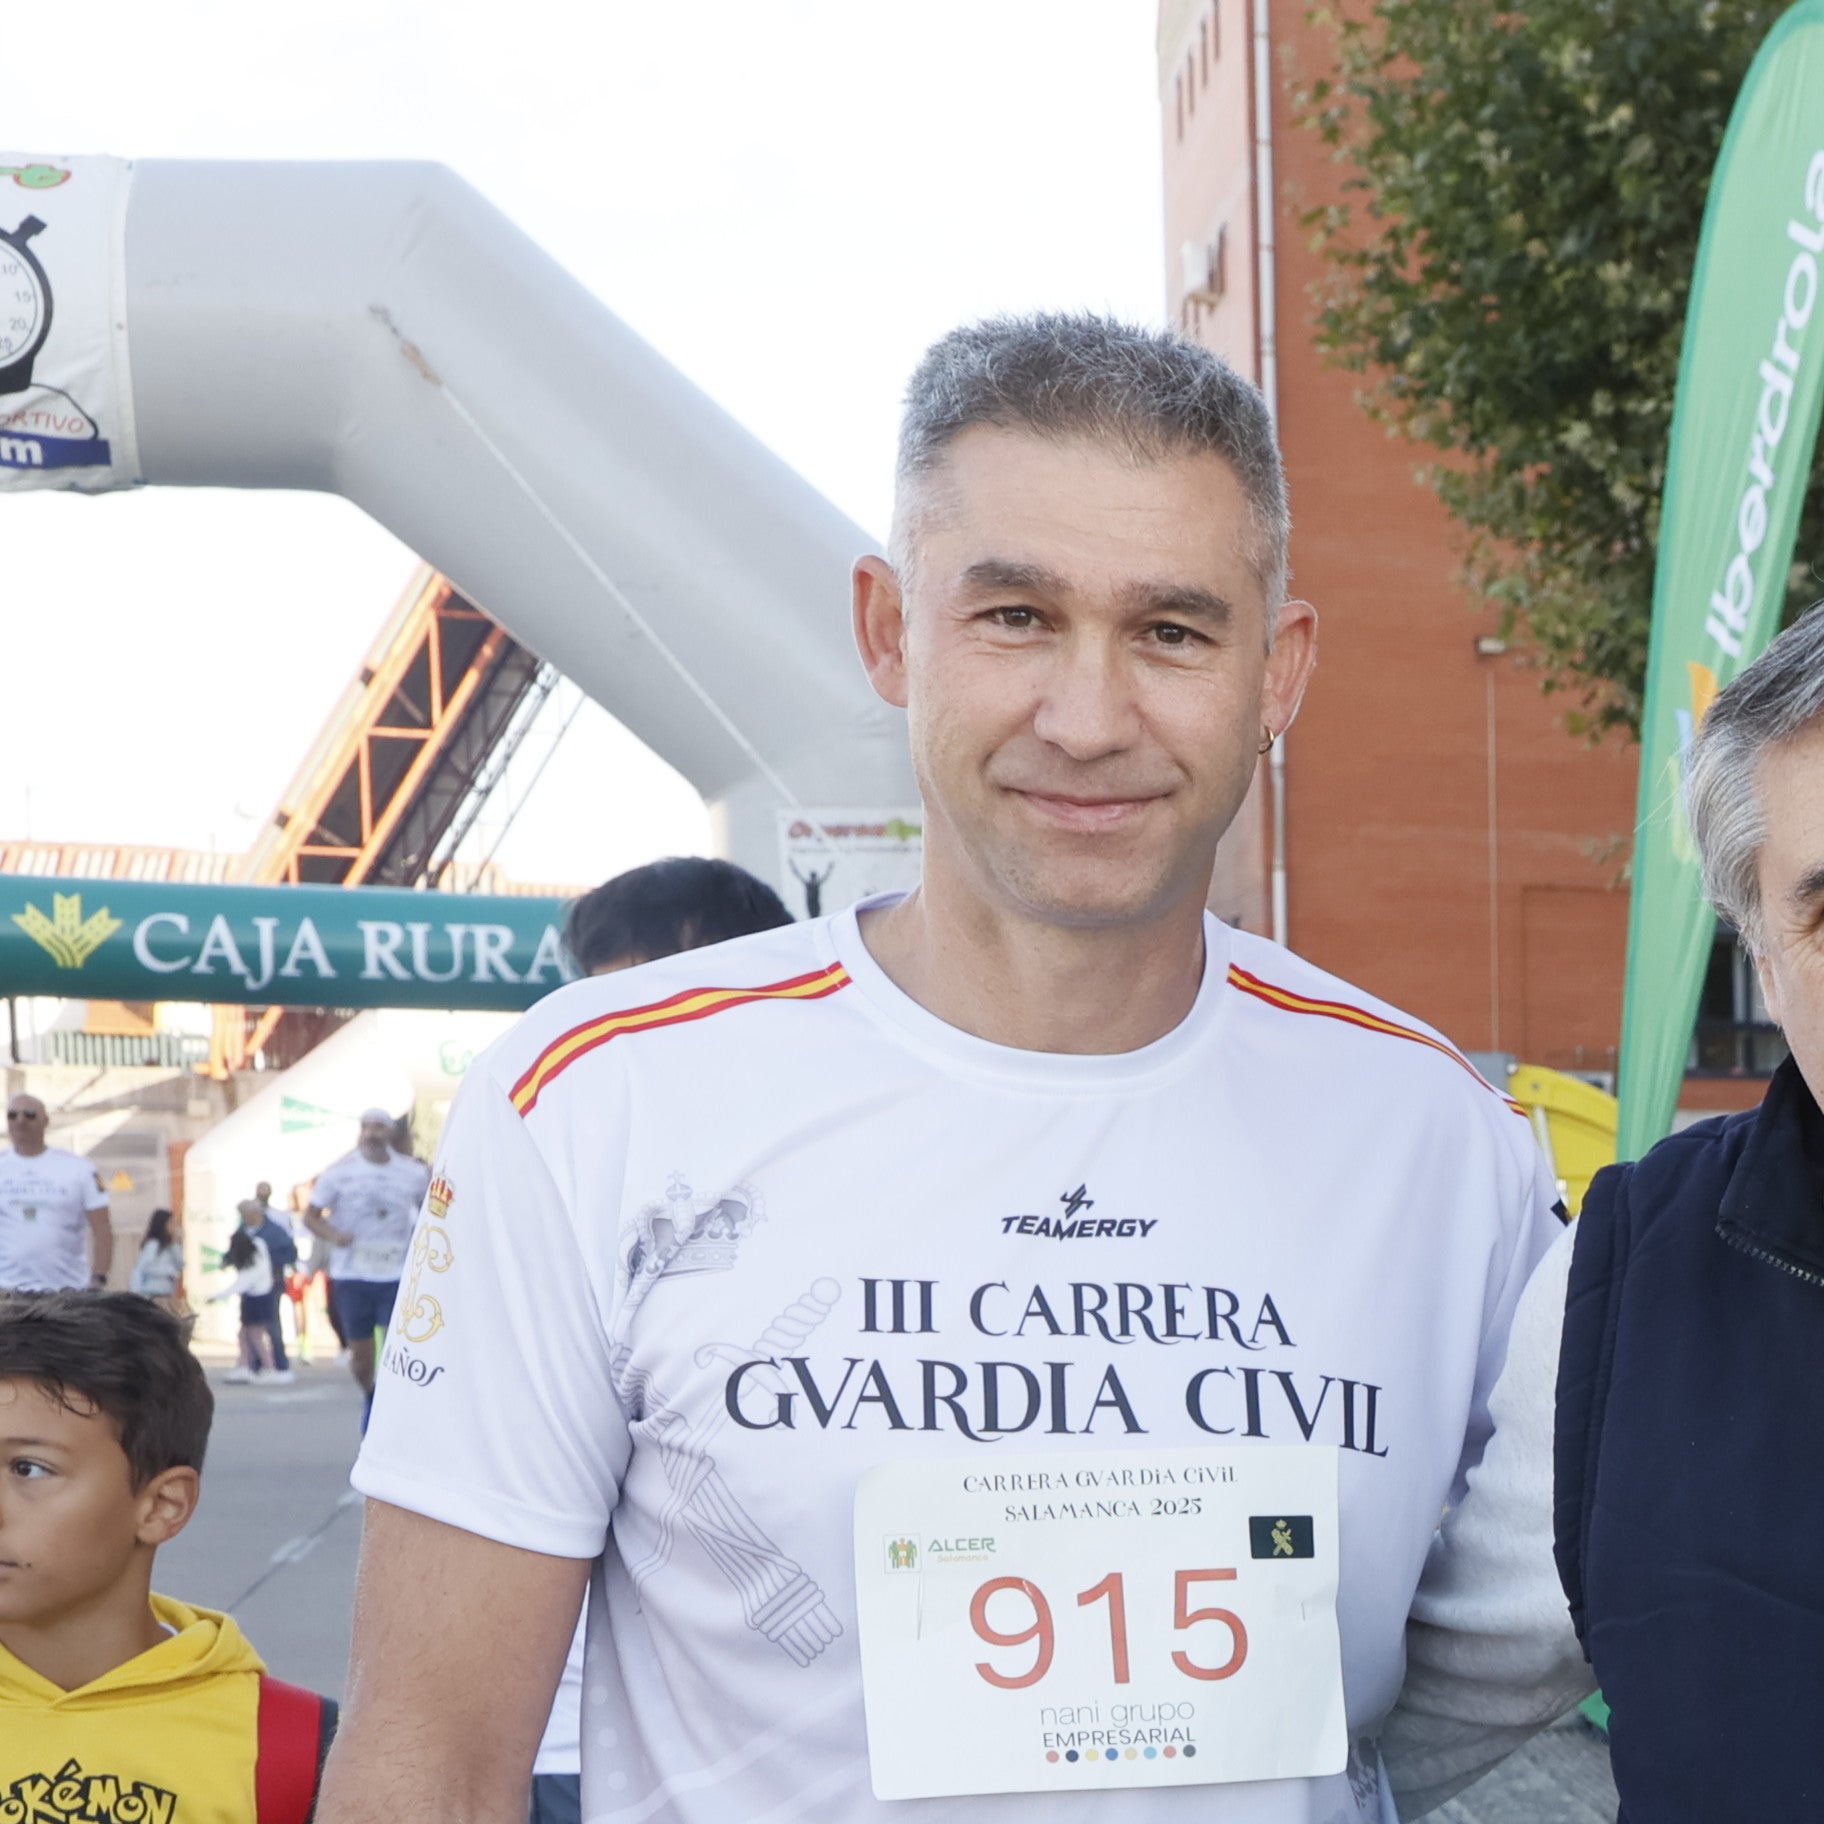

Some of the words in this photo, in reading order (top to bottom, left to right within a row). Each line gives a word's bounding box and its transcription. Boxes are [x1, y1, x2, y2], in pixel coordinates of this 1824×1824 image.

[132, 911, 337, 991] CAJA
[1001, 1215, 1159, 1242] TEAMERGY
[857, 1277, 941, 1334] III
[969, 1280, 1297, 1351] CARRERA
[725, 1356, 1150, 1443] GVARDIA
[1185, 1365, 1389, 1458] CIVIL
[963, 1471, 1070, 1493] CARRERA
[1004, 1501, 1141, 1523] SALAMANCA
[1150, 1497, 1203, 1516] 2025
[928, 1536, 997, 1552] ALCER
[969, 1567, 1249, 1690] 915
[1040, 1700, 1101, 1727] nani
[1110, 1701, 1196, 1729] grupo
[1043, 1726, 1197, 1749] EMPRESARIAL
